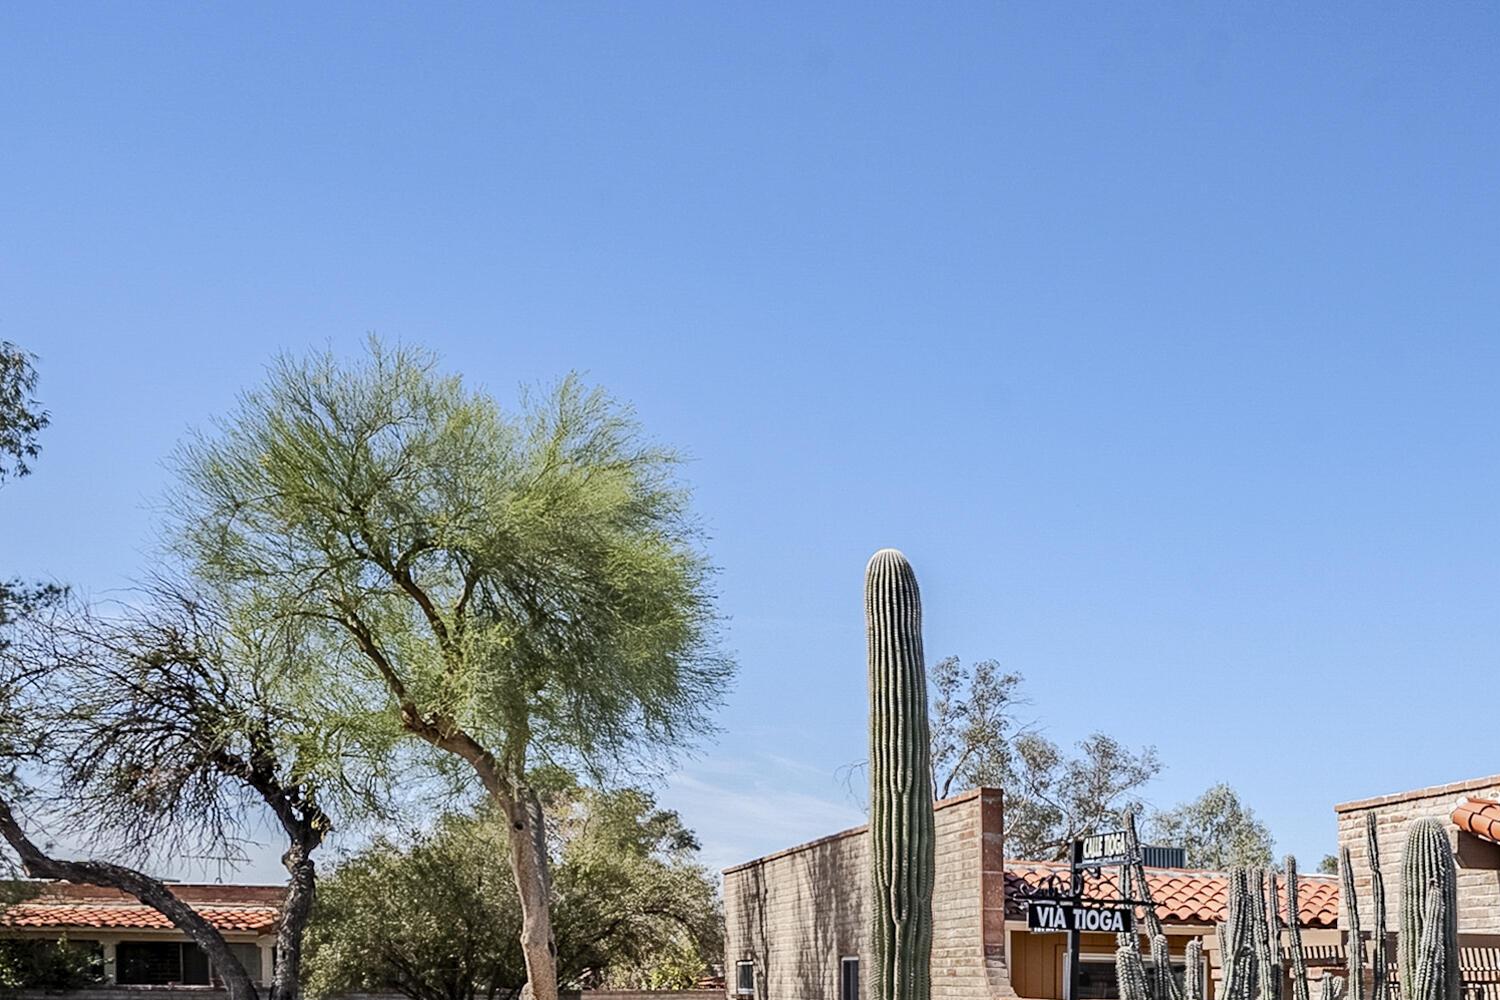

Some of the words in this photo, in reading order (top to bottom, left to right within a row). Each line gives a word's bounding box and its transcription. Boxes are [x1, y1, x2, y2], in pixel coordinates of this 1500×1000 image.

[1083, 835, 1103, 859] CALLE
[1104, 832, 1125, 856] TIOGA
[1036, 906, 1067, 928] VIA
[1073, 908, 1124, 931] TIOGA
